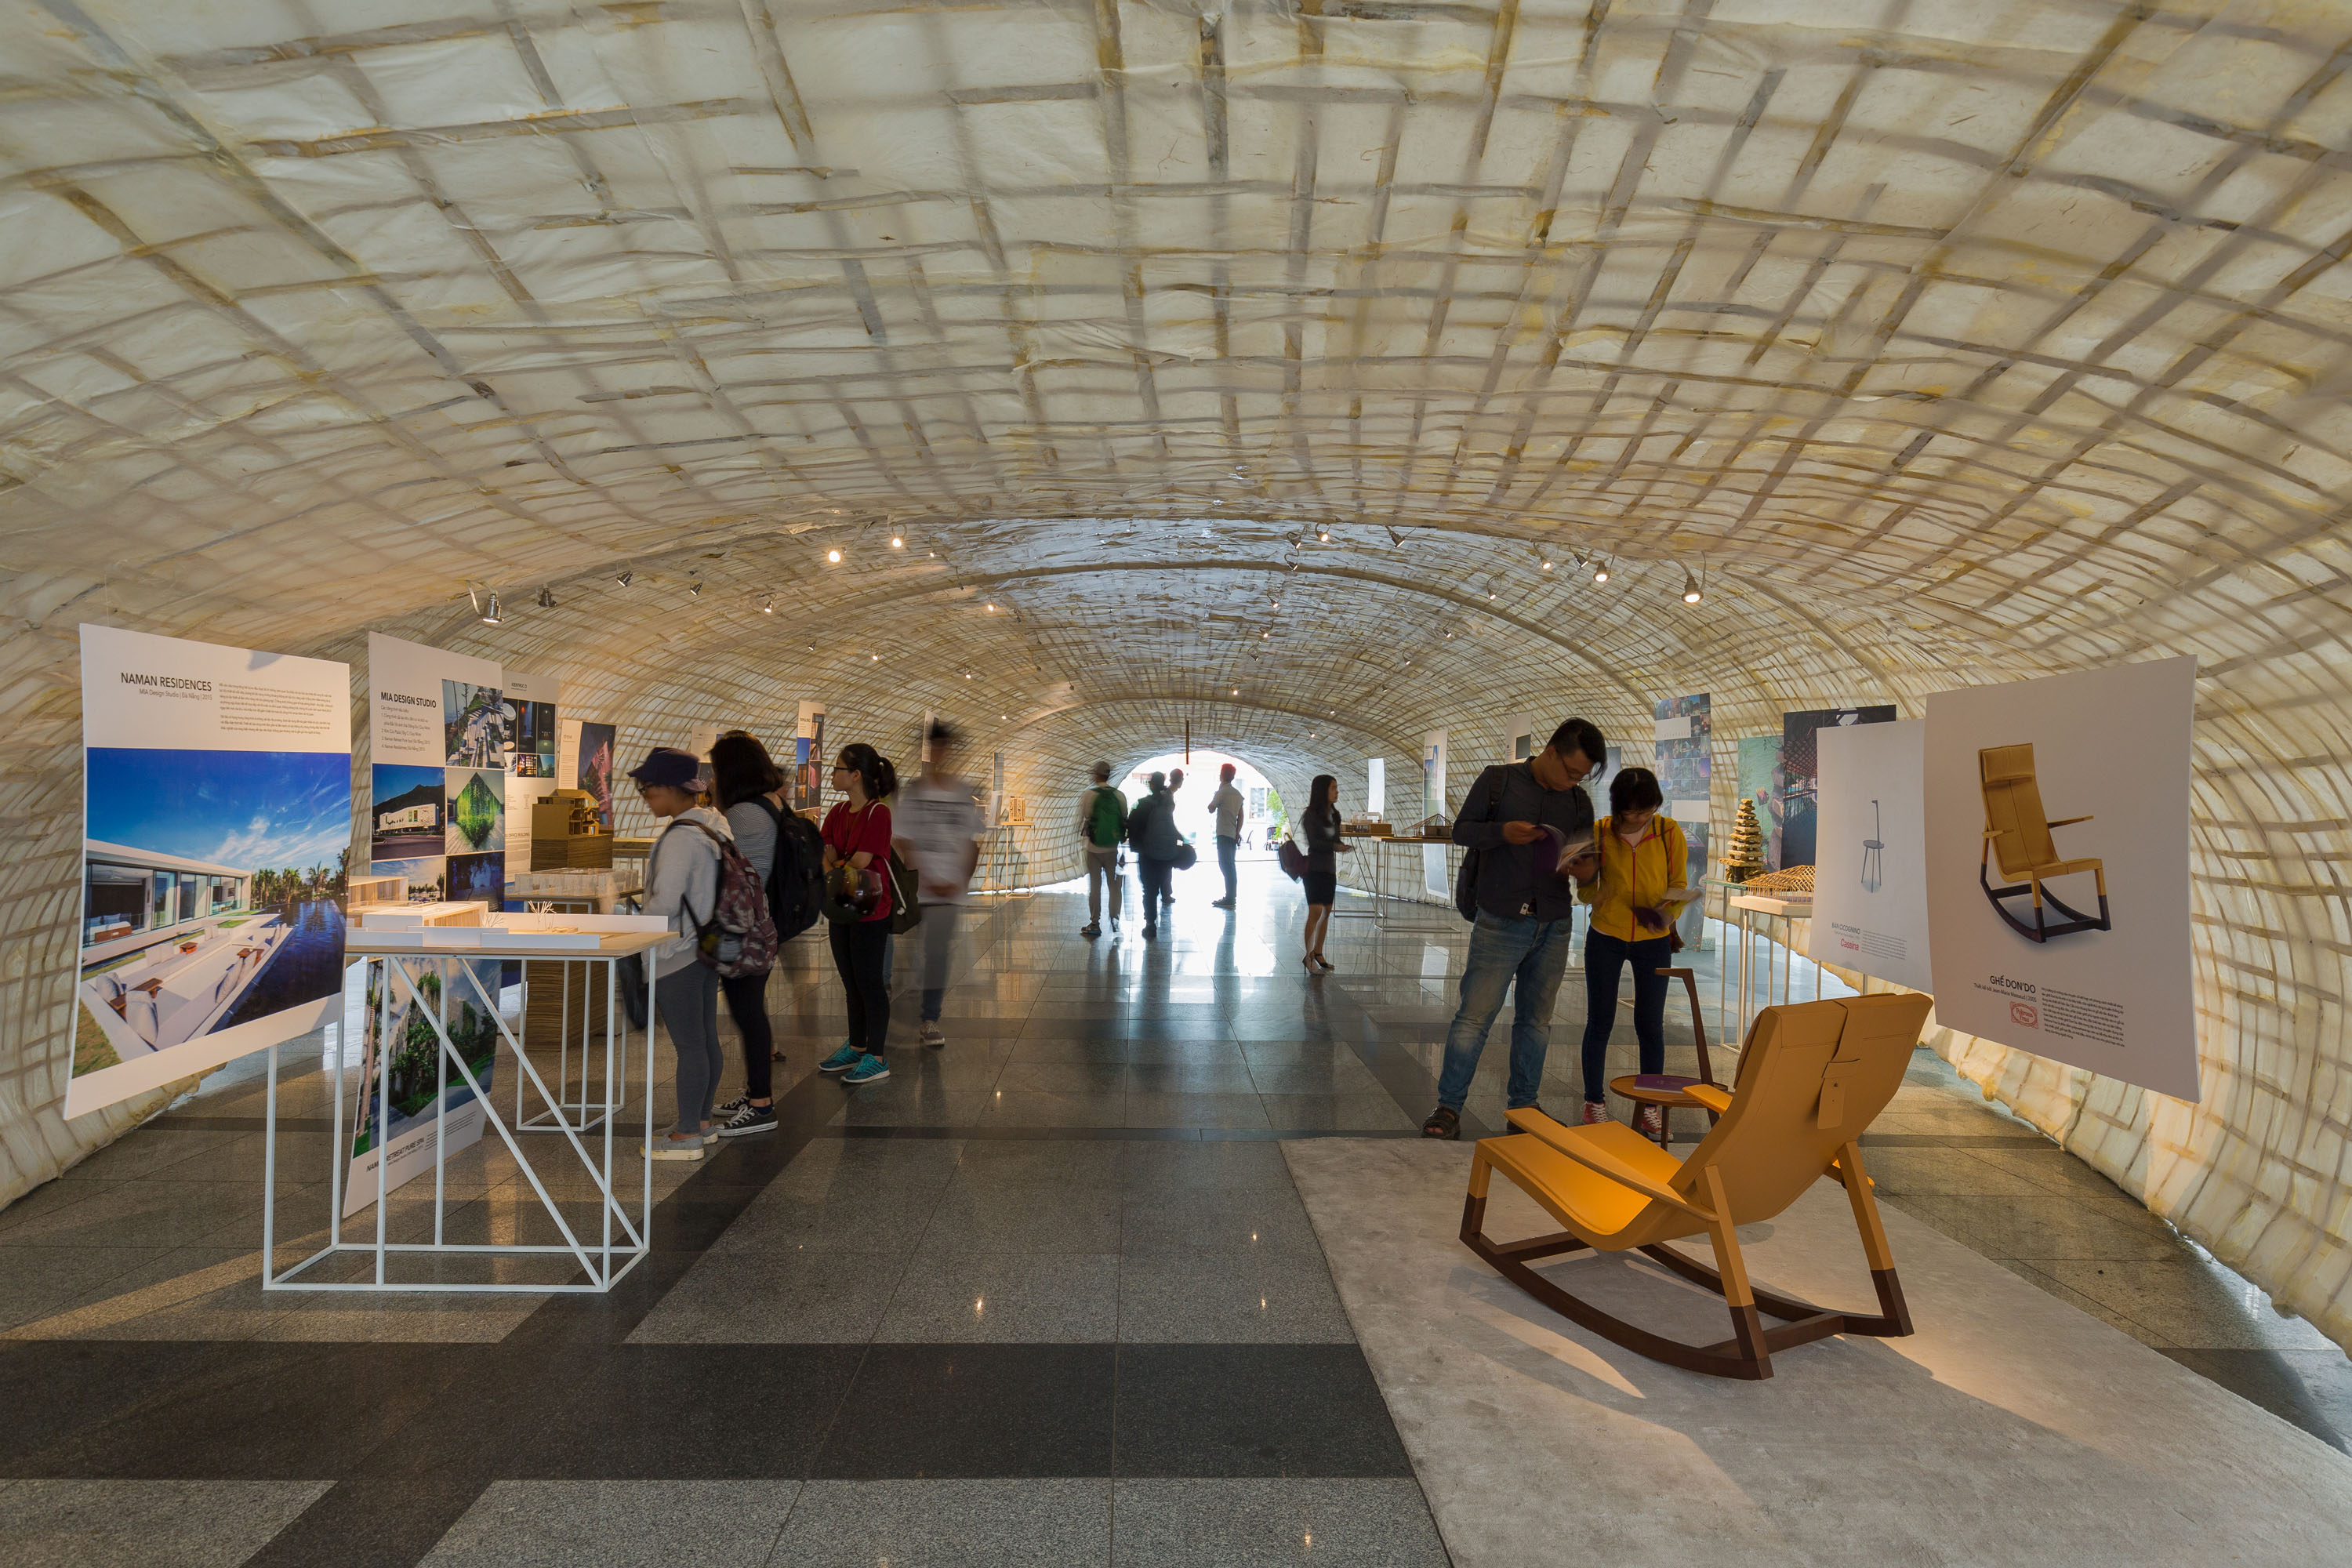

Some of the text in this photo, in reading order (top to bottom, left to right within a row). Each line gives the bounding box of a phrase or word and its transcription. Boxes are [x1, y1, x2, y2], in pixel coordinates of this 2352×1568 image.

[121, 672, 211, 691] NAMAN RESIDENCES
[381, 691, 436, 708] MIA DESIGN STUDIO
[1840, 938, 1859, 951] Cassina
[1990, 975, 2004, 986] GHẾ
